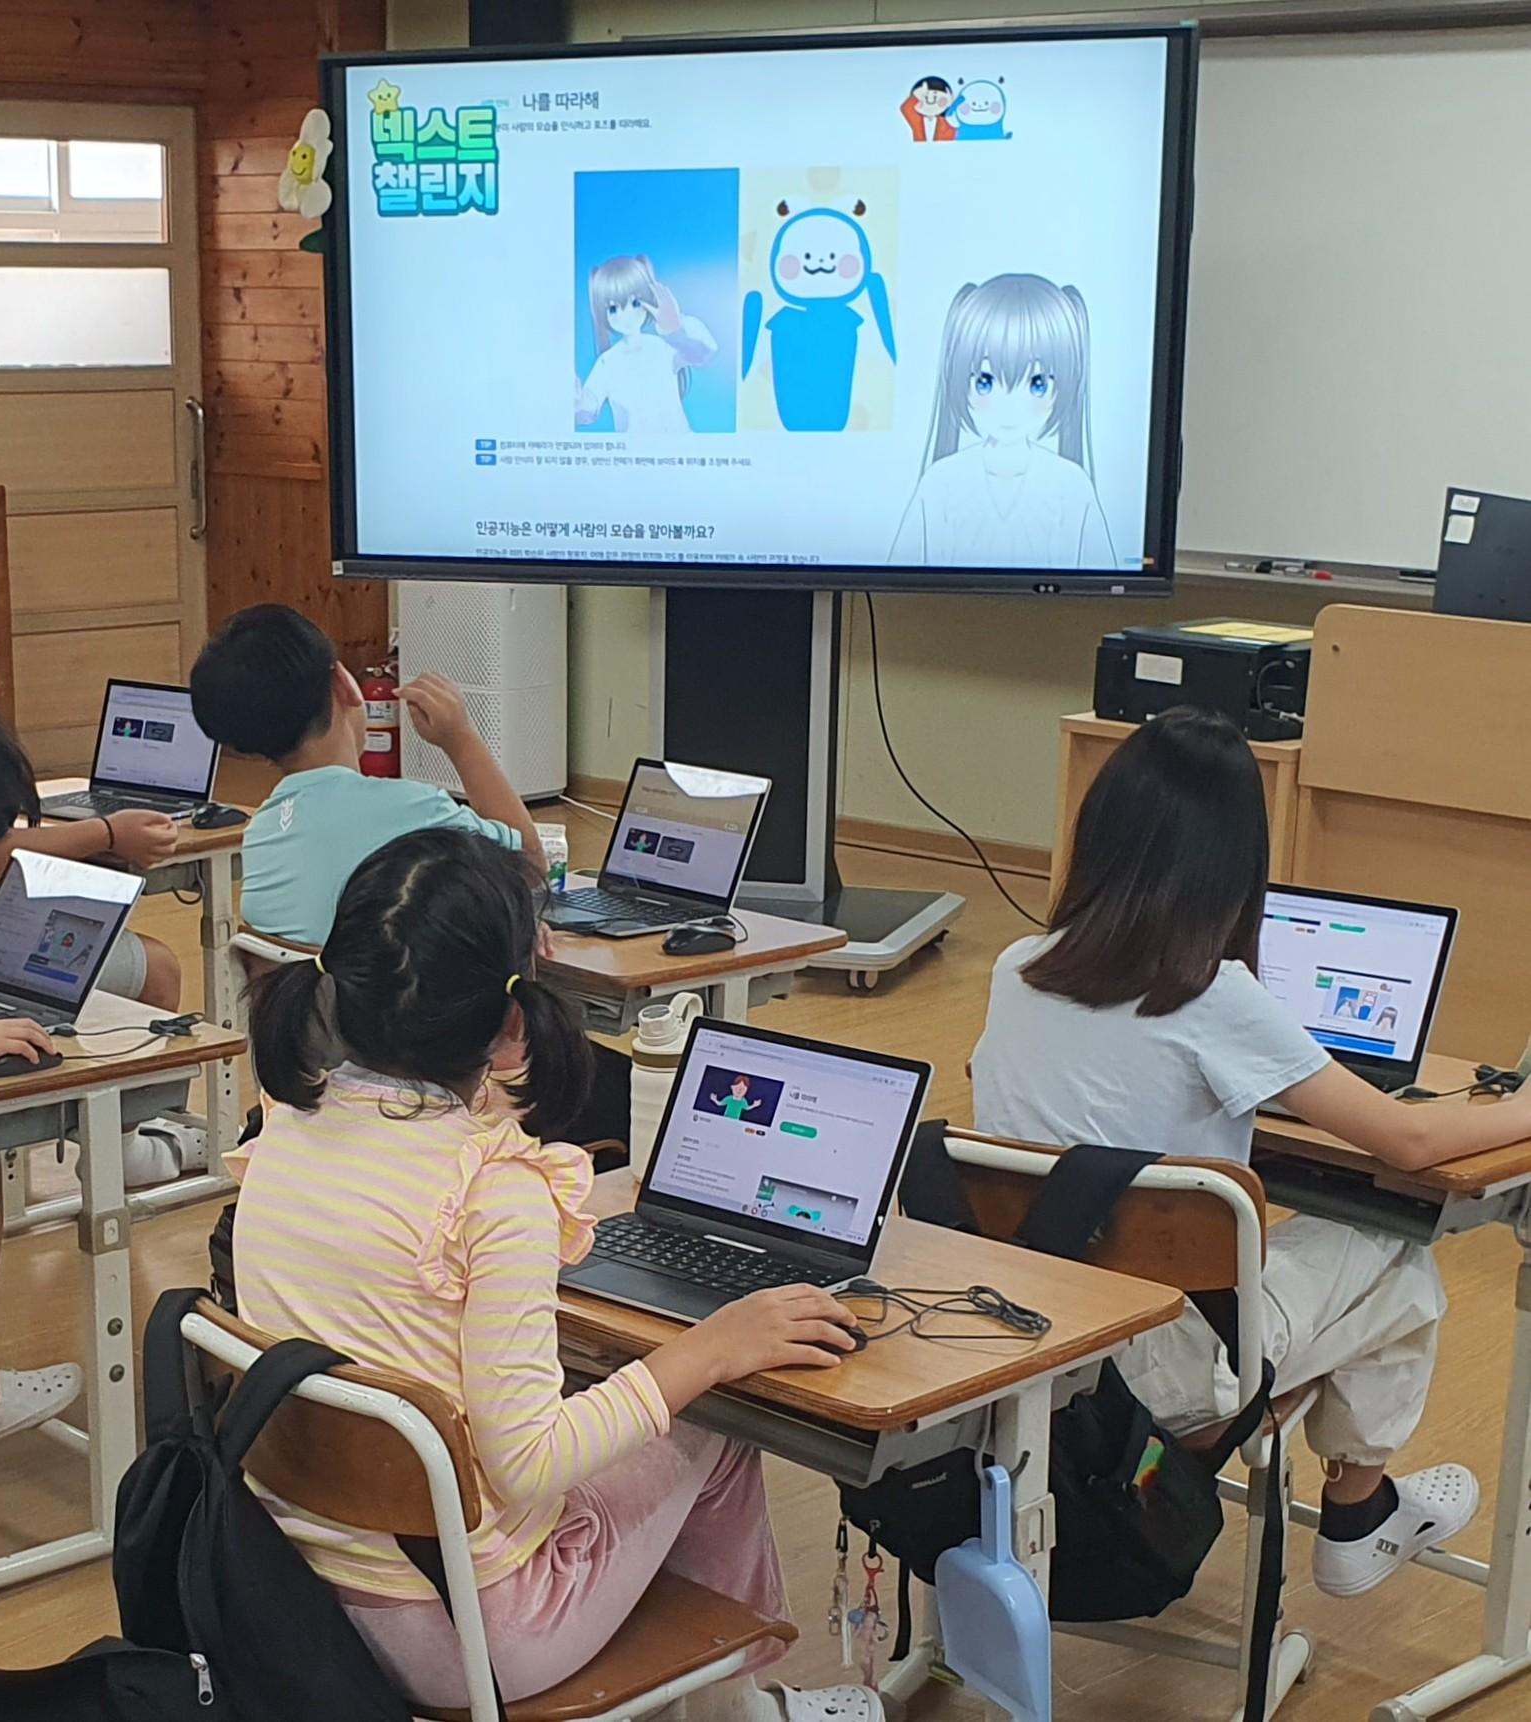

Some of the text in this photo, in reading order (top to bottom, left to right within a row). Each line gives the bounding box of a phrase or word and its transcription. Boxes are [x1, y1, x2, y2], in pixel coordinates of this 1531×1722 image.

[523, 92, 550, 111] 나를
[555, 91, 599, 110] 따라해
[371, 106, 499, 162] 넥스트
[373, 161, 499, 217] 챌린지
[476, 521, 716, 540] 인공지능은 어떻게 사람의 모습을 알아볼까요?
